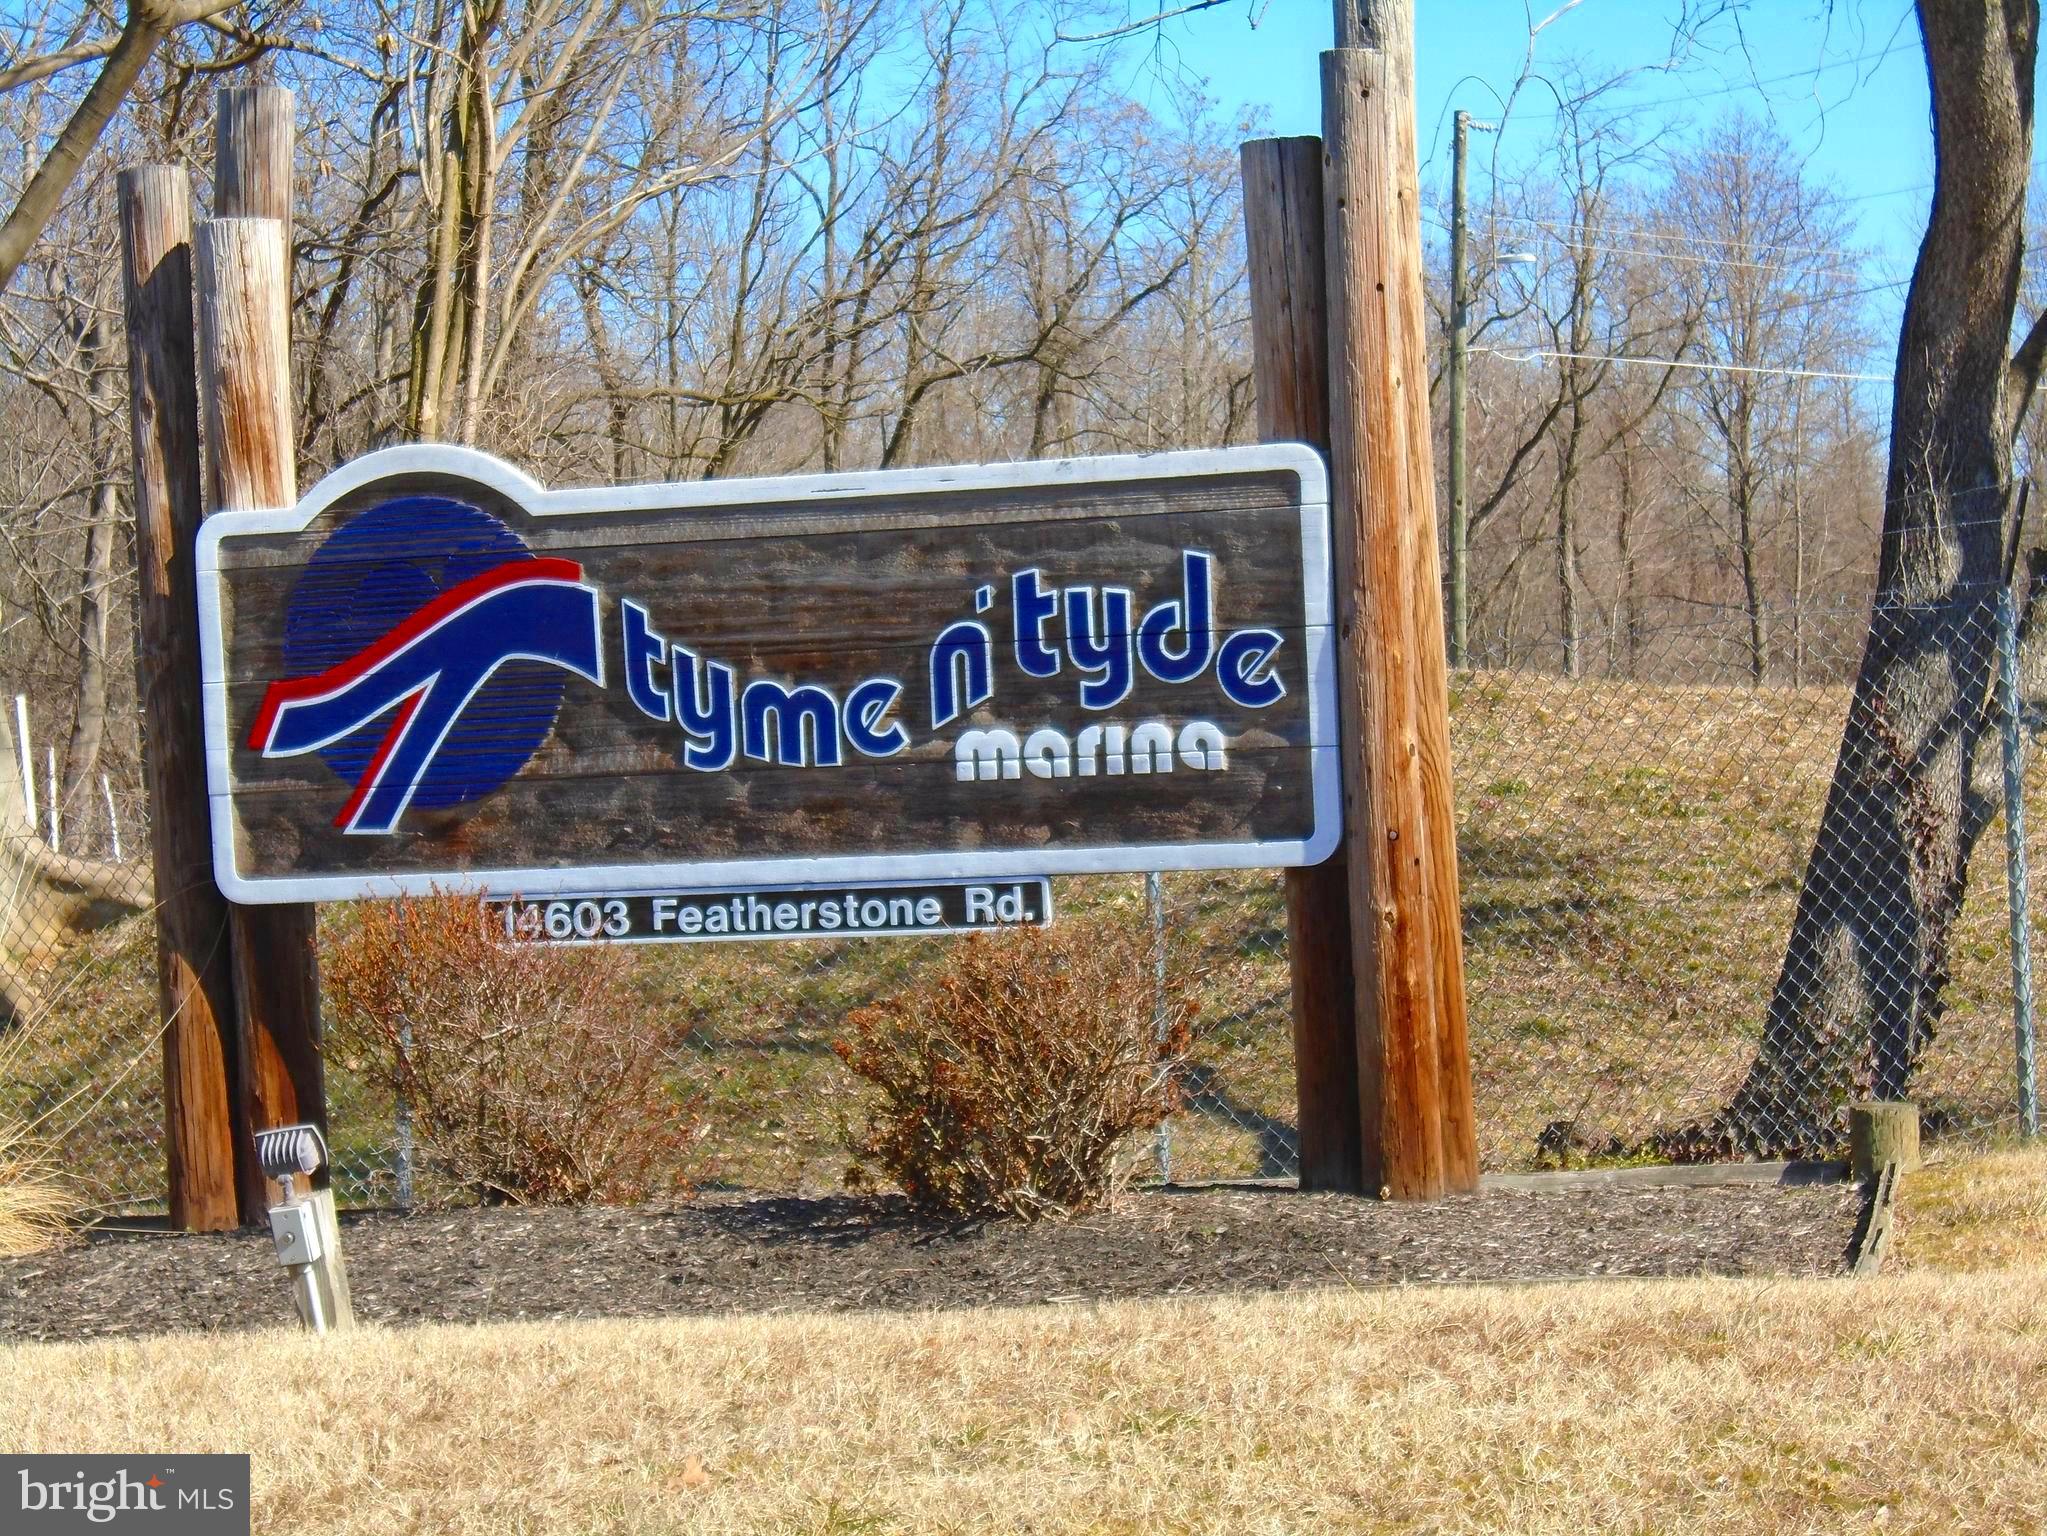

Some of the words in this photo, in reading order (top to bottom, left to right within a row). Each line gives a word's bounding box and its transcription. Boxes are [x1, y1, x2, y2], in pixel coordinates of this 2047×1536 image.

[622, 598, 911, 772] tyme
[955, 720, 1226, 782] marina
[652, 893, 941, 934] Featherstone
[965, 886, 1034, 923] Rd.
